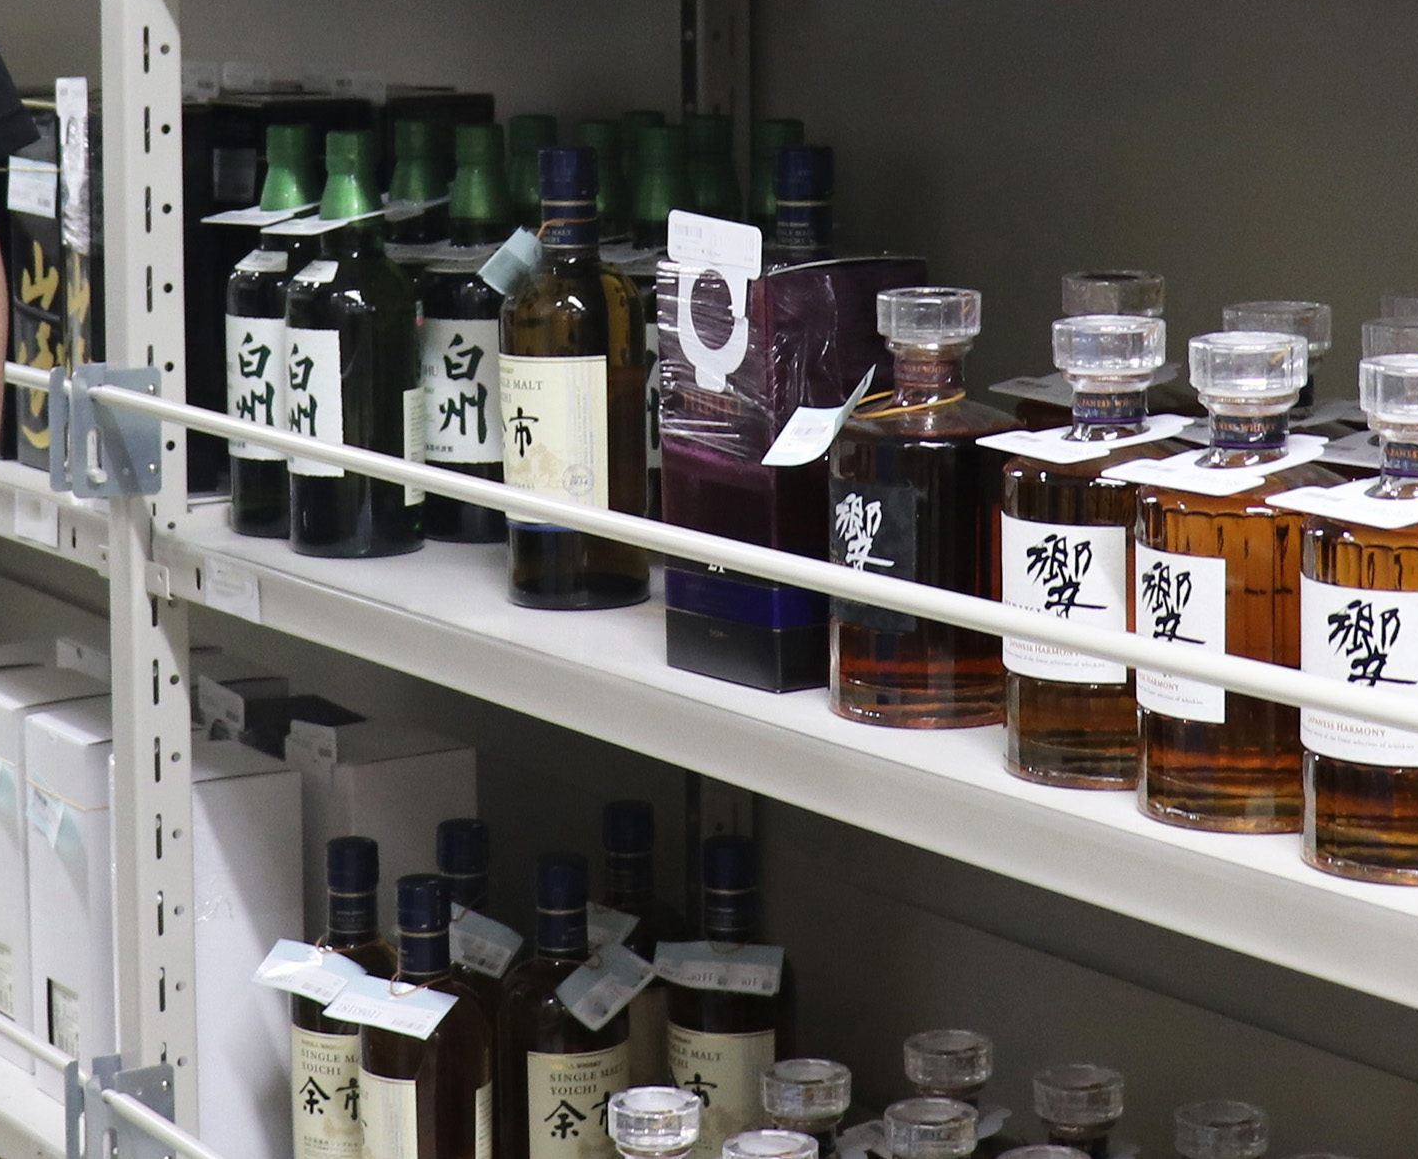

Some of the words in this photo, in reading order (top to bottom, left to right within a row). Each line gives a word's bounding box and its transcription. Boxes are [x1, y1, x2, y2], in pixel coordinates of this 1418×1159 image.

[234, 332, 275, 427] 白州
[287, 344, 319, 439] 白州
[438, 334, 488, 445] 白州
[513, 379, 544, 391] MALT
[502, 405, 540, 458] 市
[835, 493, 895, 572] 響
[1026, 534, 1107, 619] 響
[1141, 561, 1206, 644] 響
[1327, 599, 1418, 687] 響
[1335, 721, 1387, 738] HARMONY
[300, 1048, 340, 1063] SINGLE
[344, 1054, 359, 1064] MA
[300, 1061, 341, 1076] YOICHI
[549, 1070, 599, 1083] SINGLE
[689, 1049, 722, 1062] MALT
[298, 1075, 360, 1122] 余市
[549, 1083, 598, 1097] YOICHI
